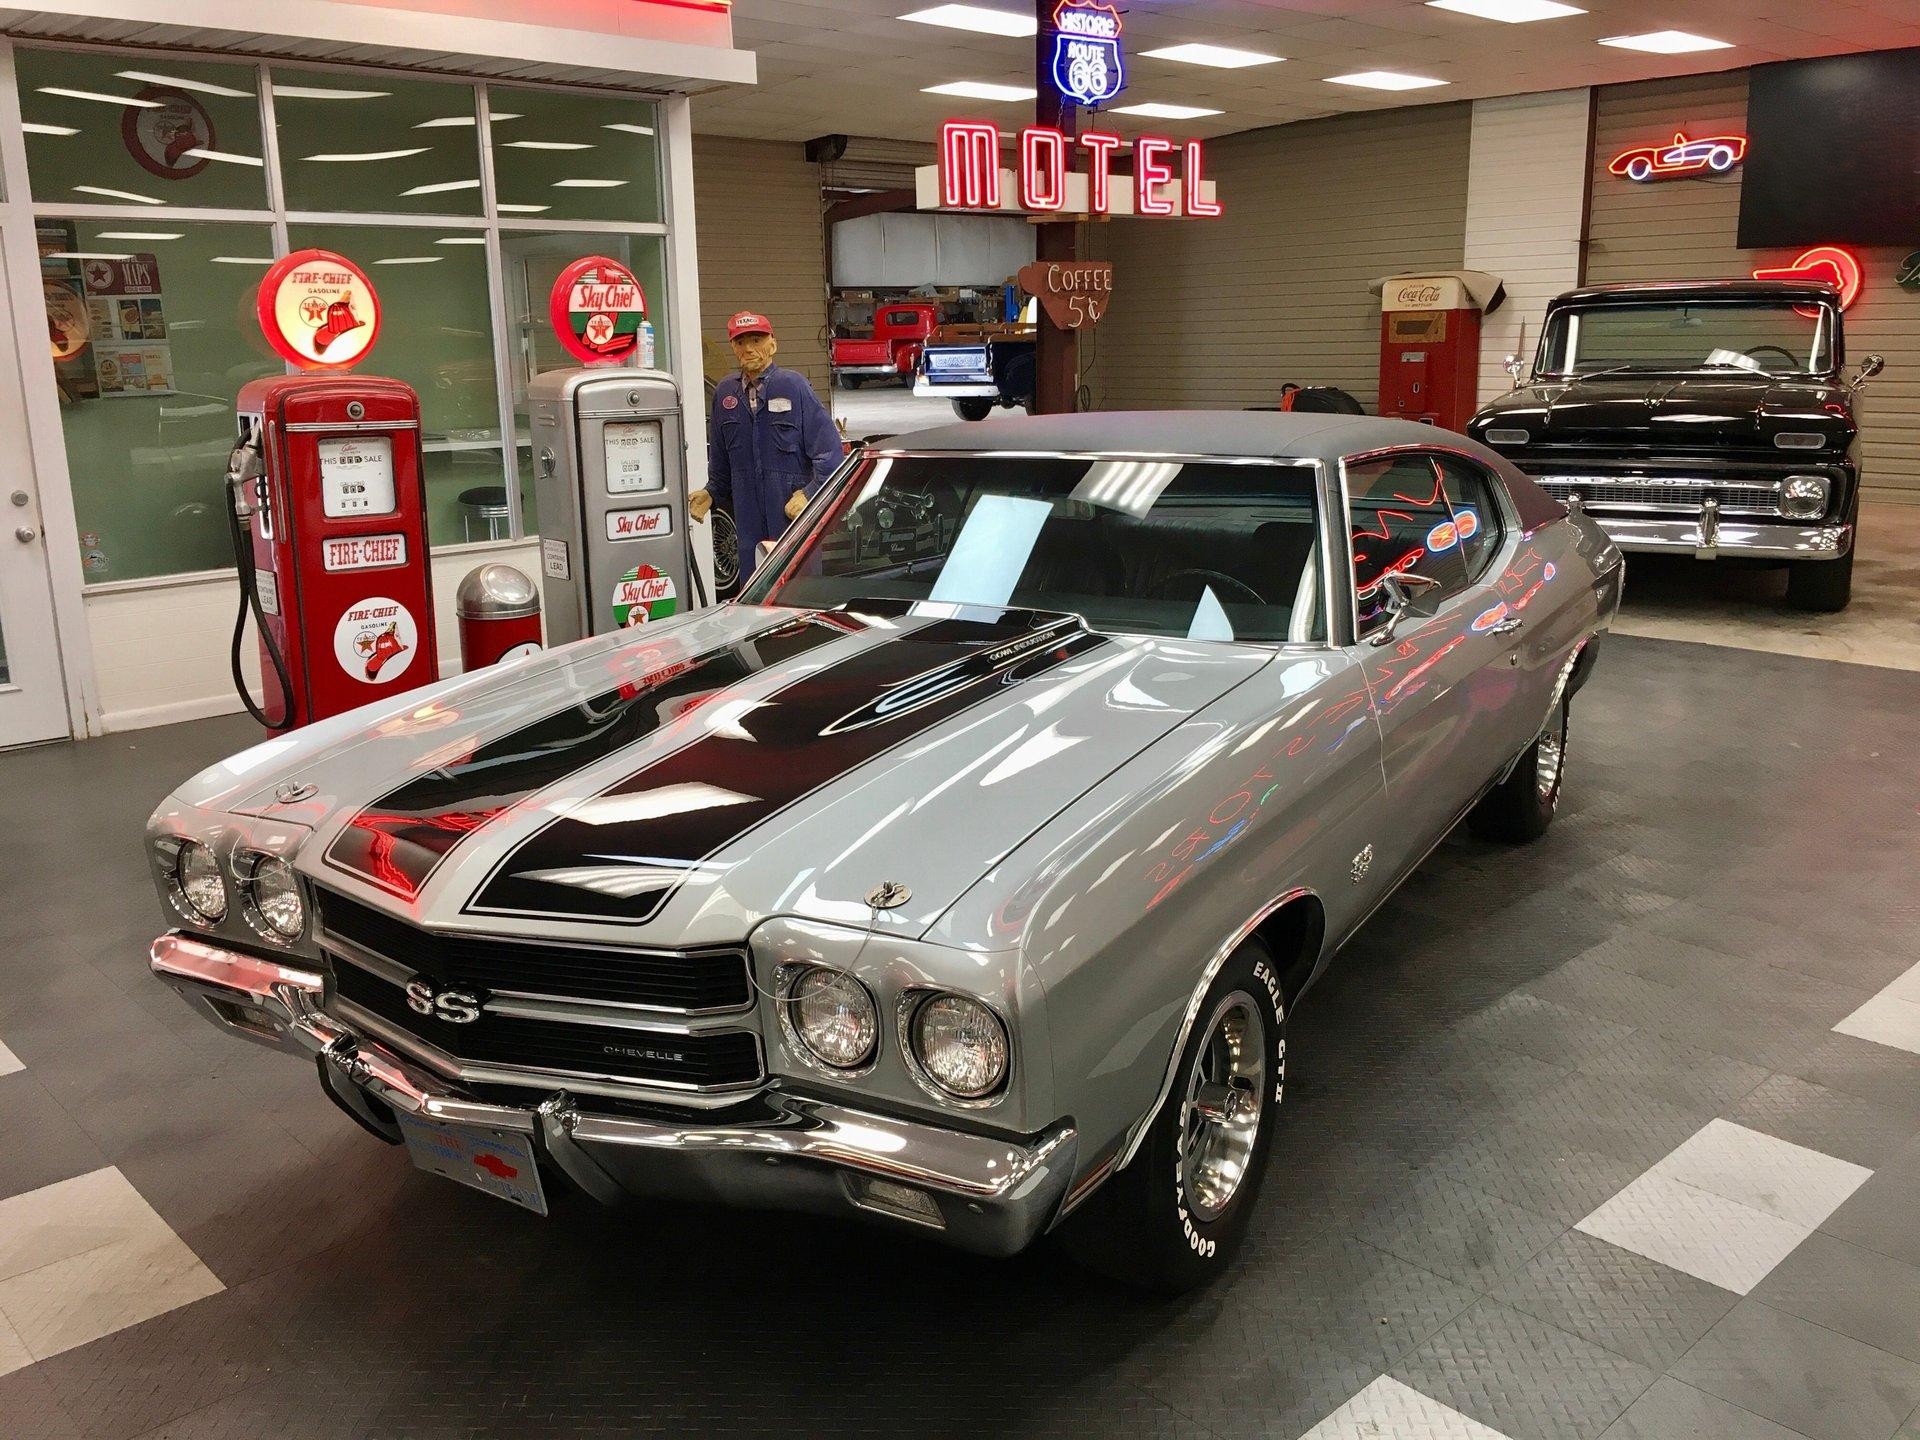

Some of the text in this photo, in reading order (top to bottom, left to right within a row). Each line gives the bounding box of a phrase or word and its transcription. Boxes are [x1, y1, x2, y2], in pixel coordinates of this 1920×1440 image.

[1068, 41, 1105, 60] ROUTE
[1069, 58, 1108, 95] 66
[937, 119, 1226, 217] MOTEL
[121, 263, 151, 285] MAPS
[292, 272, 353, 285] FIRE-CHIEF
[1048, 263, 1112, 294] COFFEE
[579, 285, 635, 311] Sky Chief
[1397, 286, 1442, 302] Coca-Cola
[736, 317, 758, 326] TEXACO
[1067, 295, 1100, 328] 5¢
[640, 436, 655, 444] SALE
[320, 457, 337, 466] THIS
[364, 455, 383, 463] SALE
[616, 513, 660, 534] Sky Chief
[549, 562, 564, 571] LEAD
[621, 578, 668, 603] Sky Chief
[347, 605, 399, 622] FIRE-CHIEF
[361, 621, 388, 630] GASOLINE
[989, 630, 1056, 662] COWL INDUCTION
[405, 980, 480, 1024] SS
[1252, 960, 1285, 1025] EAGLE
[603, 1046, 683, 1062] CHEVELLE
